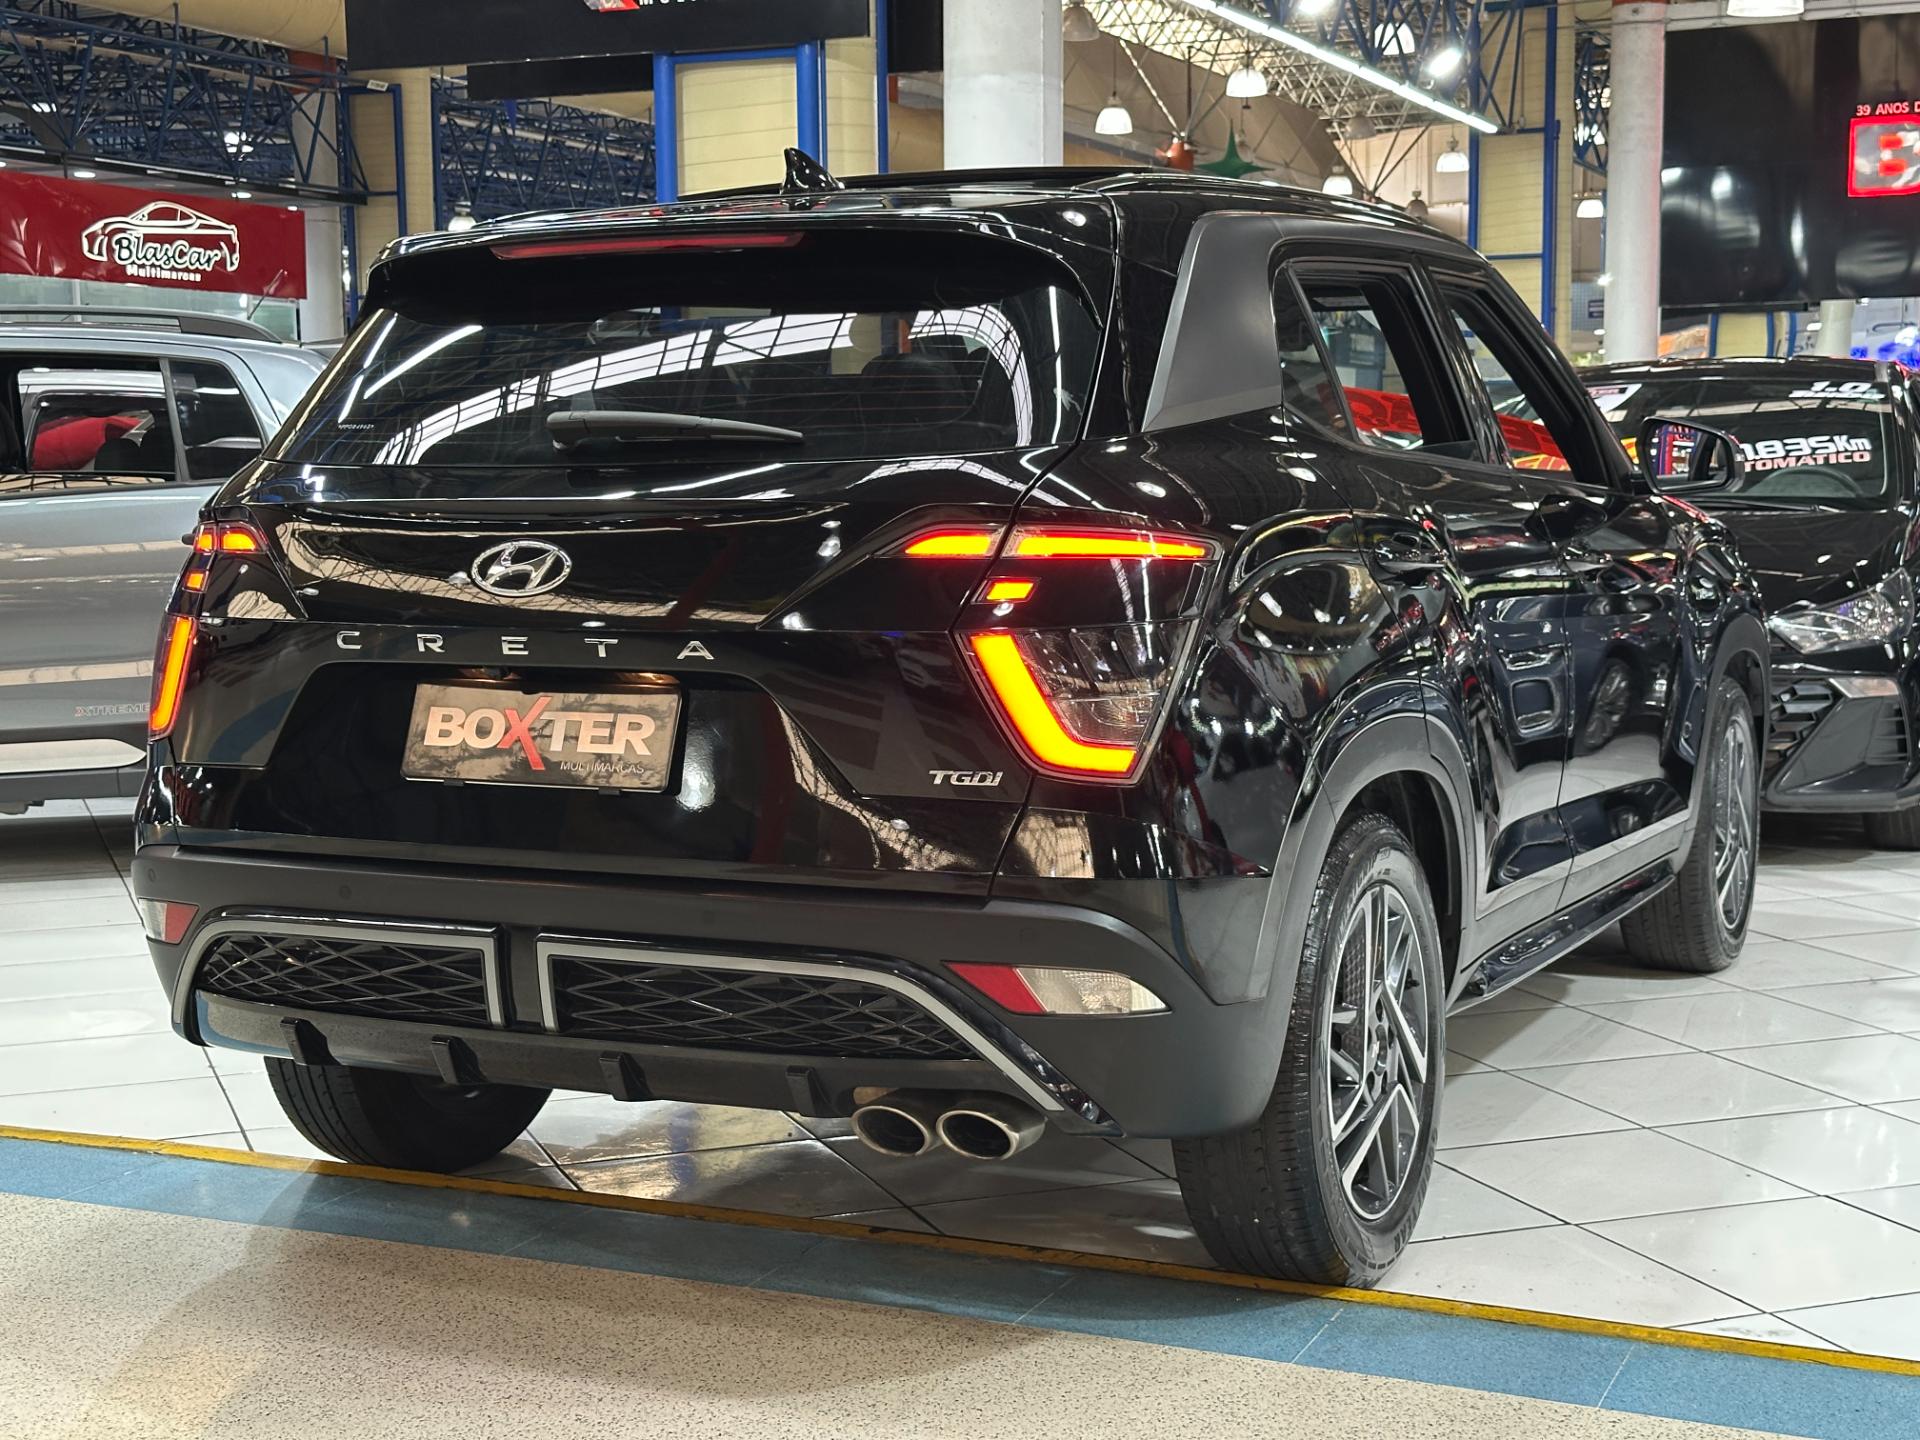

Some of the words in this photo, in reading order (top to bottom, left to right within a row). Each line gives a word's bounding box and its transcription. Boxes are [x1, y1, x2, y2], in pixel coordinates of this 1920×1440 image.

[1856, 104, 1871, 116] 39
[1875, 102, 1909, 115] ANOS
[112, 232, 221, 271] BlasCar
[126, 264, 201, 282] Multimarcas
[1744, 451, 1872, 472] TOMATICO
[336, 630, 715, 660] CRETA
[423, 695, 656, 771] BOXTER
[560, 760, 645, 774] MULTIMARCAS
